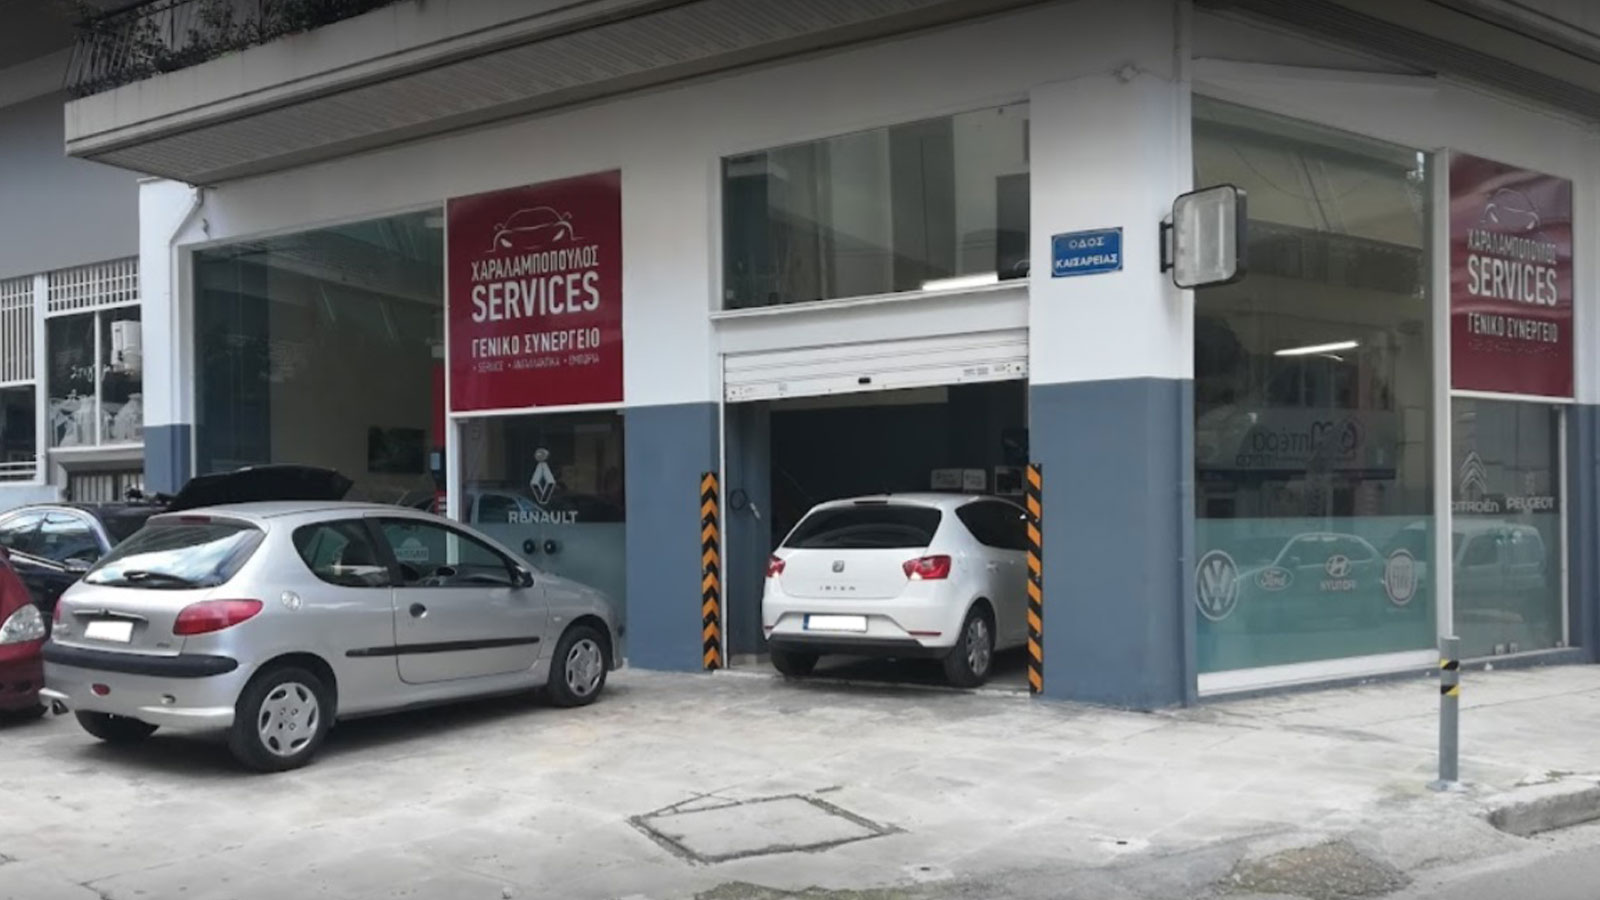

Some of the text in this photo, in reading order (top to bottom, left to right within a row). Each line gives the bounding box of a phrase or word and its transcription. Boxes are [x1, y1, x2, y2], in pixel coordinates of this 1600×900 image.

[1068, 236, 1104, 249] ΟΔΟΣ
[471, 245, 599, 281] ΧΑΡΑΛΑΜΠΟΠΟΥΛΟΣ
[1055, 253, 1118, 269] ΚΑΙΣΑΡΕΙΑΣ
[1468, 254, 1557, 306] SERVICES
[472, 271, 599, 323] SERVICES
[1468, 312, 1558, 343] ΓΕΝΙΚΟ ΣΥΝΕΡΓΕΙΟ
[472, 328, 600, 358] ΓΕΝΙΚΟ ΣΥΝΕΡΓΕΙΟ
[508, 510, 579, 524] RENAULT
